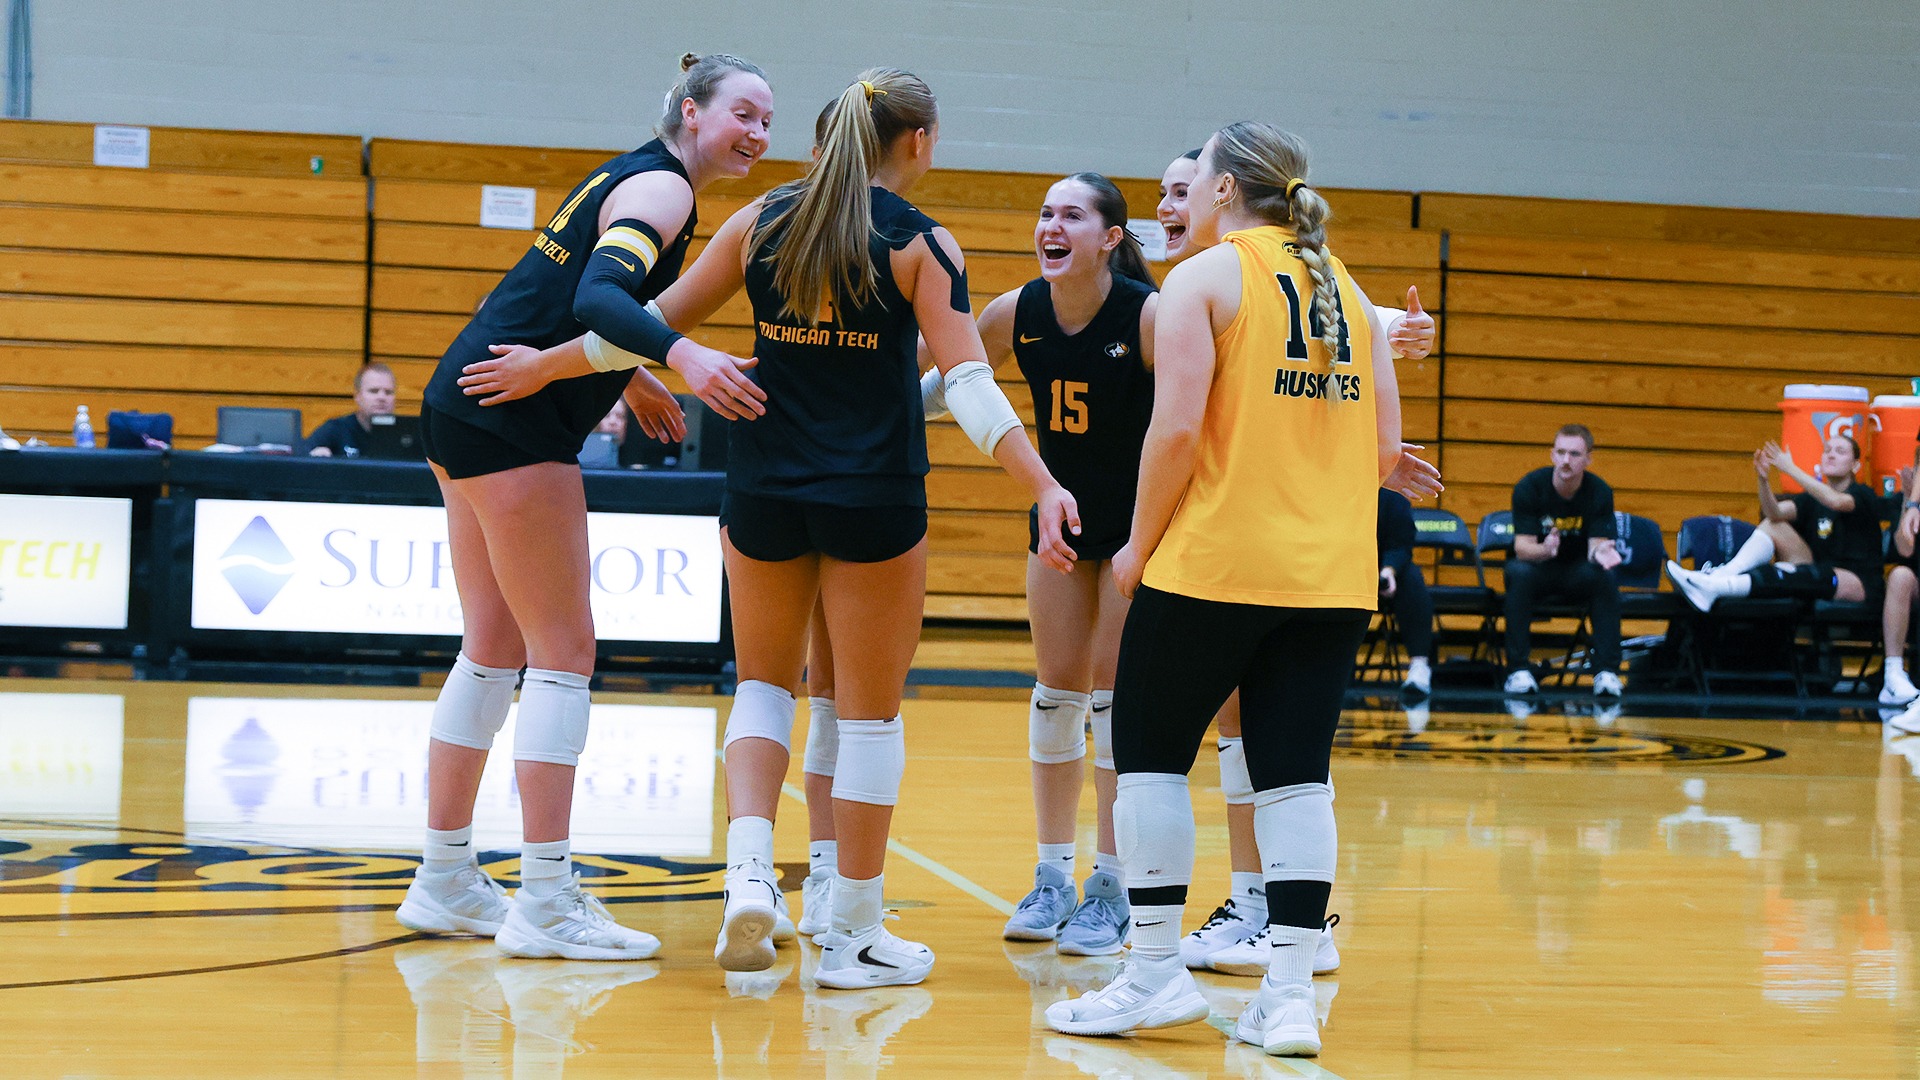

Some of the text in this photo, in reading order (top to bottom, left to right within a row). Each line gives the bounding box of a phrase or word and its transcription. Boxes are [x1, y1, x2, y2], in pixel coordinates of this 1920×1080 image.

[543, 239, 571, 266] TECH
[758, 321, 879, 350] MICHIGAN TECH
[1275, 272, 1352, 365] 14
[1049, 379, 1089, 435] 15
[320, 528, 694, 597] SUPOR
